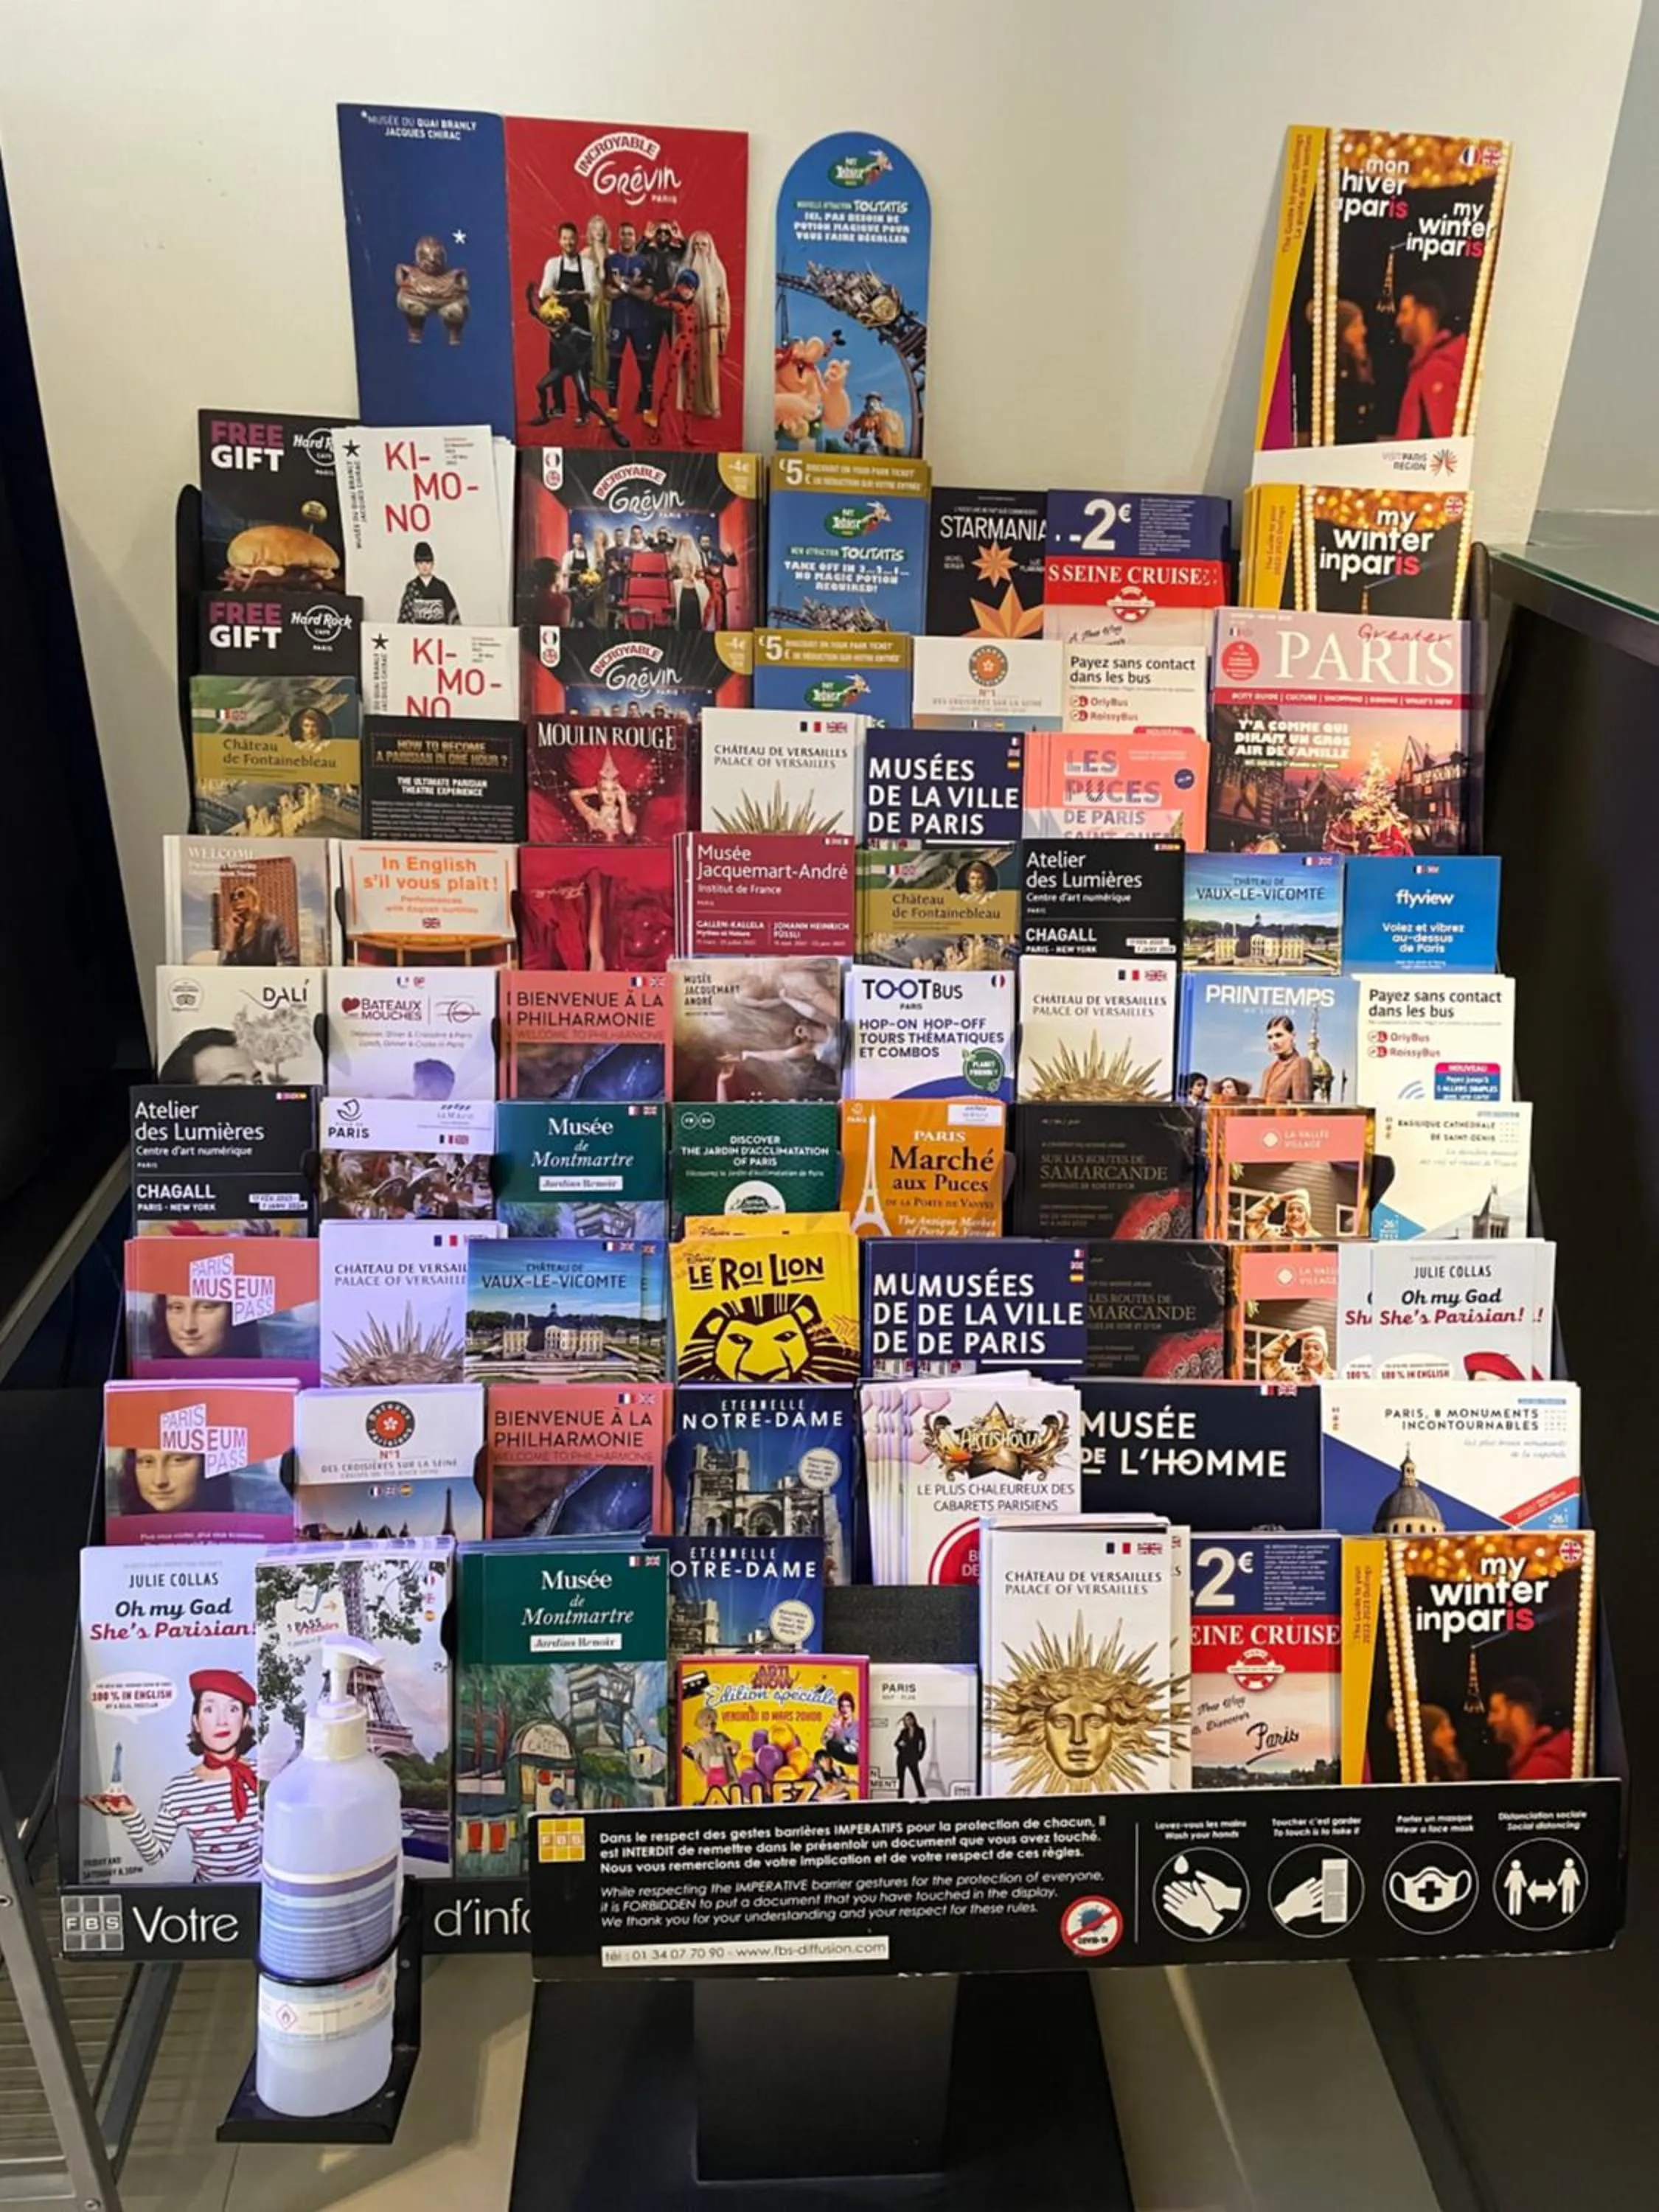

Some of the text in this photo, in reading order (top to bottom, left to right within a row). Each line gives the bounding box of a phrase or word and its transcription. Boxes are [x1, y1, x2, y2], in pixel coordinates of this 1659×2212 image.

[385, 127, 425, 139] JACQUES
[578, 136, 657, 173] INCROYABLE
[1366, 158, 1410, 174] mon
[594, 161, 681, 195] Grévin
[1343, 167, 1406, 195] hiver
[1453, 202, 1484, 220] my
[1419, 214, 1495, 239] winter
[1406, 232, 1484, 261] inparis
[211, 420, 284, 446] FREE
[211, 445, 284, 473] GIFT
[384, 440, 431, 470] KI-
[413, 473, 479, 501] MO-
[594, 465, 665, 498] INCROYABLE
[609, 487, 684, 515] Grévin
[384, 504, 431, 533] NO
[940, 515, 1046, 541] STARMANIA
[1377, 509, 1416, 532] my
[1334, 526, 1434, 552] winter
[1062, 565, 1121, 582] SEINE
[1319, 547, 1422, 582] inparis
[209, 602, 282, 625] FREE
[291, 611, 352, 631] Hard Rock
[209, 625, 282, 649] GIFT
[1357, 622, 1453, 643] Greater
[412, 638, 456, 665] KI-
[1275, 630, 1455, 687] PARIS
[1071, 656, 1195, 671] Payez sans contact
[437, 669, 501, 695] MO-
[1070, 672, 1151, 684] dans les bus
[406, 696, 451, 718] NO
[223, 738, 278, 753] Château
[538, 722, 677, 750] MOULIN ROUGE
[223, 752, 337, 768] de Fontainebleau
[869, 753, 975, 781] MUSÉES
[869, 785, 1019, 808] DE LA VILLE
[868, 813, 984, 835] DE PARIS
[698, 845, 752, 860] Musée
[1026, 852, 1086, 868] Atelier
[383, 856, 476, 874] In English
[697, 863, 849, 881] Jacquemart-André
[396, 878, 442, 890] vous
[1026, 871, 1142, 888] des Lumières
[1197, 887, 1324, 900] VAUX-LE-VICOMTE
[1395, 890, 1454, 908] flyview
[1026, 928, 1096, 942] CHAGALL
[361, 998, 421, 1010] BATEAUX
[517, 987, 664, 1007] BIENVENUE À LA
[1206, 984, 1335, 1007] PRINTEMPS
[361, 1010, 422, 1021] MOUCHES
[517, 1012, 655, 1027] PHILHARMONIE
[859, 1018, 986, 1030] HOP-ON HOP-OFF
[860, 1029, 1004, 1043] TOURS THÉMATIQUES
[859, 1046, 939, 1058] ET COMBOS
[135, 1102, 198, 1119] Atelier
[135, 1123, 265, 1141] des Lumières
[730, 1135, 781, 1145] DISCOVER
[914, 1131, 966, 1142] PARIS
[681, 1146, 829, 1156] THE JARDIN D'ACCLIMATATION
[889, 1146, 994, 1172] Marché
[734, 1157, 777, 1166] OF PARIS
[137, 1184, 215, 1199] CHAGALL
[893, 1175, 988, 1192] aux Puces
[689, 1253, 824, 1290] LE ROI LION
[1414, 1265, 1492, 1279] JULIE COLLAS
[1402, 1288, 1502, 1308] Oh my God
[1380, 1308, 1525, 1326] She's Parisian!
[162, 1406, 205, 1429] PARIS
[684, 1411, 843, 1430] NOTRE-DAME
[1080, 1405, 1196, 1439] MUSÉE
[1384, 1408, 1430, 1419] PARIS,
[1447, 1408, 1539, 1419] MONUMENTS
[1402, 1420, 1539, 1430] INCONTOURNABLES
[162, 1428, 246, 1451] MUSEUM
[206, 1450, 246, 1472] PASS
[1081, 1447, 1287, 1477] DE L'HOMME
[917, 1483, 1074, 1495] LE PLUS CHALEUREUX DES
[933, 1500, 1058, 1512] CABARETS PARISIENS
[1005, 1570, 1162, 1582] CHÂTEAU DE VERSAILLES
[1481, 1556, 1526, 1580] my
[541, 1569, 612, 1590] Musée
[1005, 1583, 1148, 1594] PALACE OF VERSAILLES
[569, 1594, 585, 1607] de
[1430, 1577, 1548, 1605] winter
[521, 1607, 634, 1626] Montmartre
[1416, 1601, 1534, 1642] inparis
[1251, 1624, 1341, 1645] CRUISE
[1246, 1721, 1300, 1752] Paris
[600, 1832, 632, 1843] Dans
[636, 1832, 647, 1842] le
[651, 1829, 700, 1844] respect
[703, 1829, 726, 1840] des
[731, 1827, 771, 1843] gestes
[775, 1825, 830, 1838] barrières
[835, 1822, 903, 1835] IMPERATIFS
[906, 1823, 936, 1836] pour
[939, 1820, 951, 1832] la
[955, 1819, 1020, 1833] protection
[1023, 1818, 1040, 1829] de
[1044, 1817, 1095, 1829] chacun,
[600, 1871, 1105, 1899] While respecting the IMPERATIVE barrier gestures for the protection of everyone.
[65, 1917, 119, 1930] FBS
[133, 1906, 239, 1944] Votre
